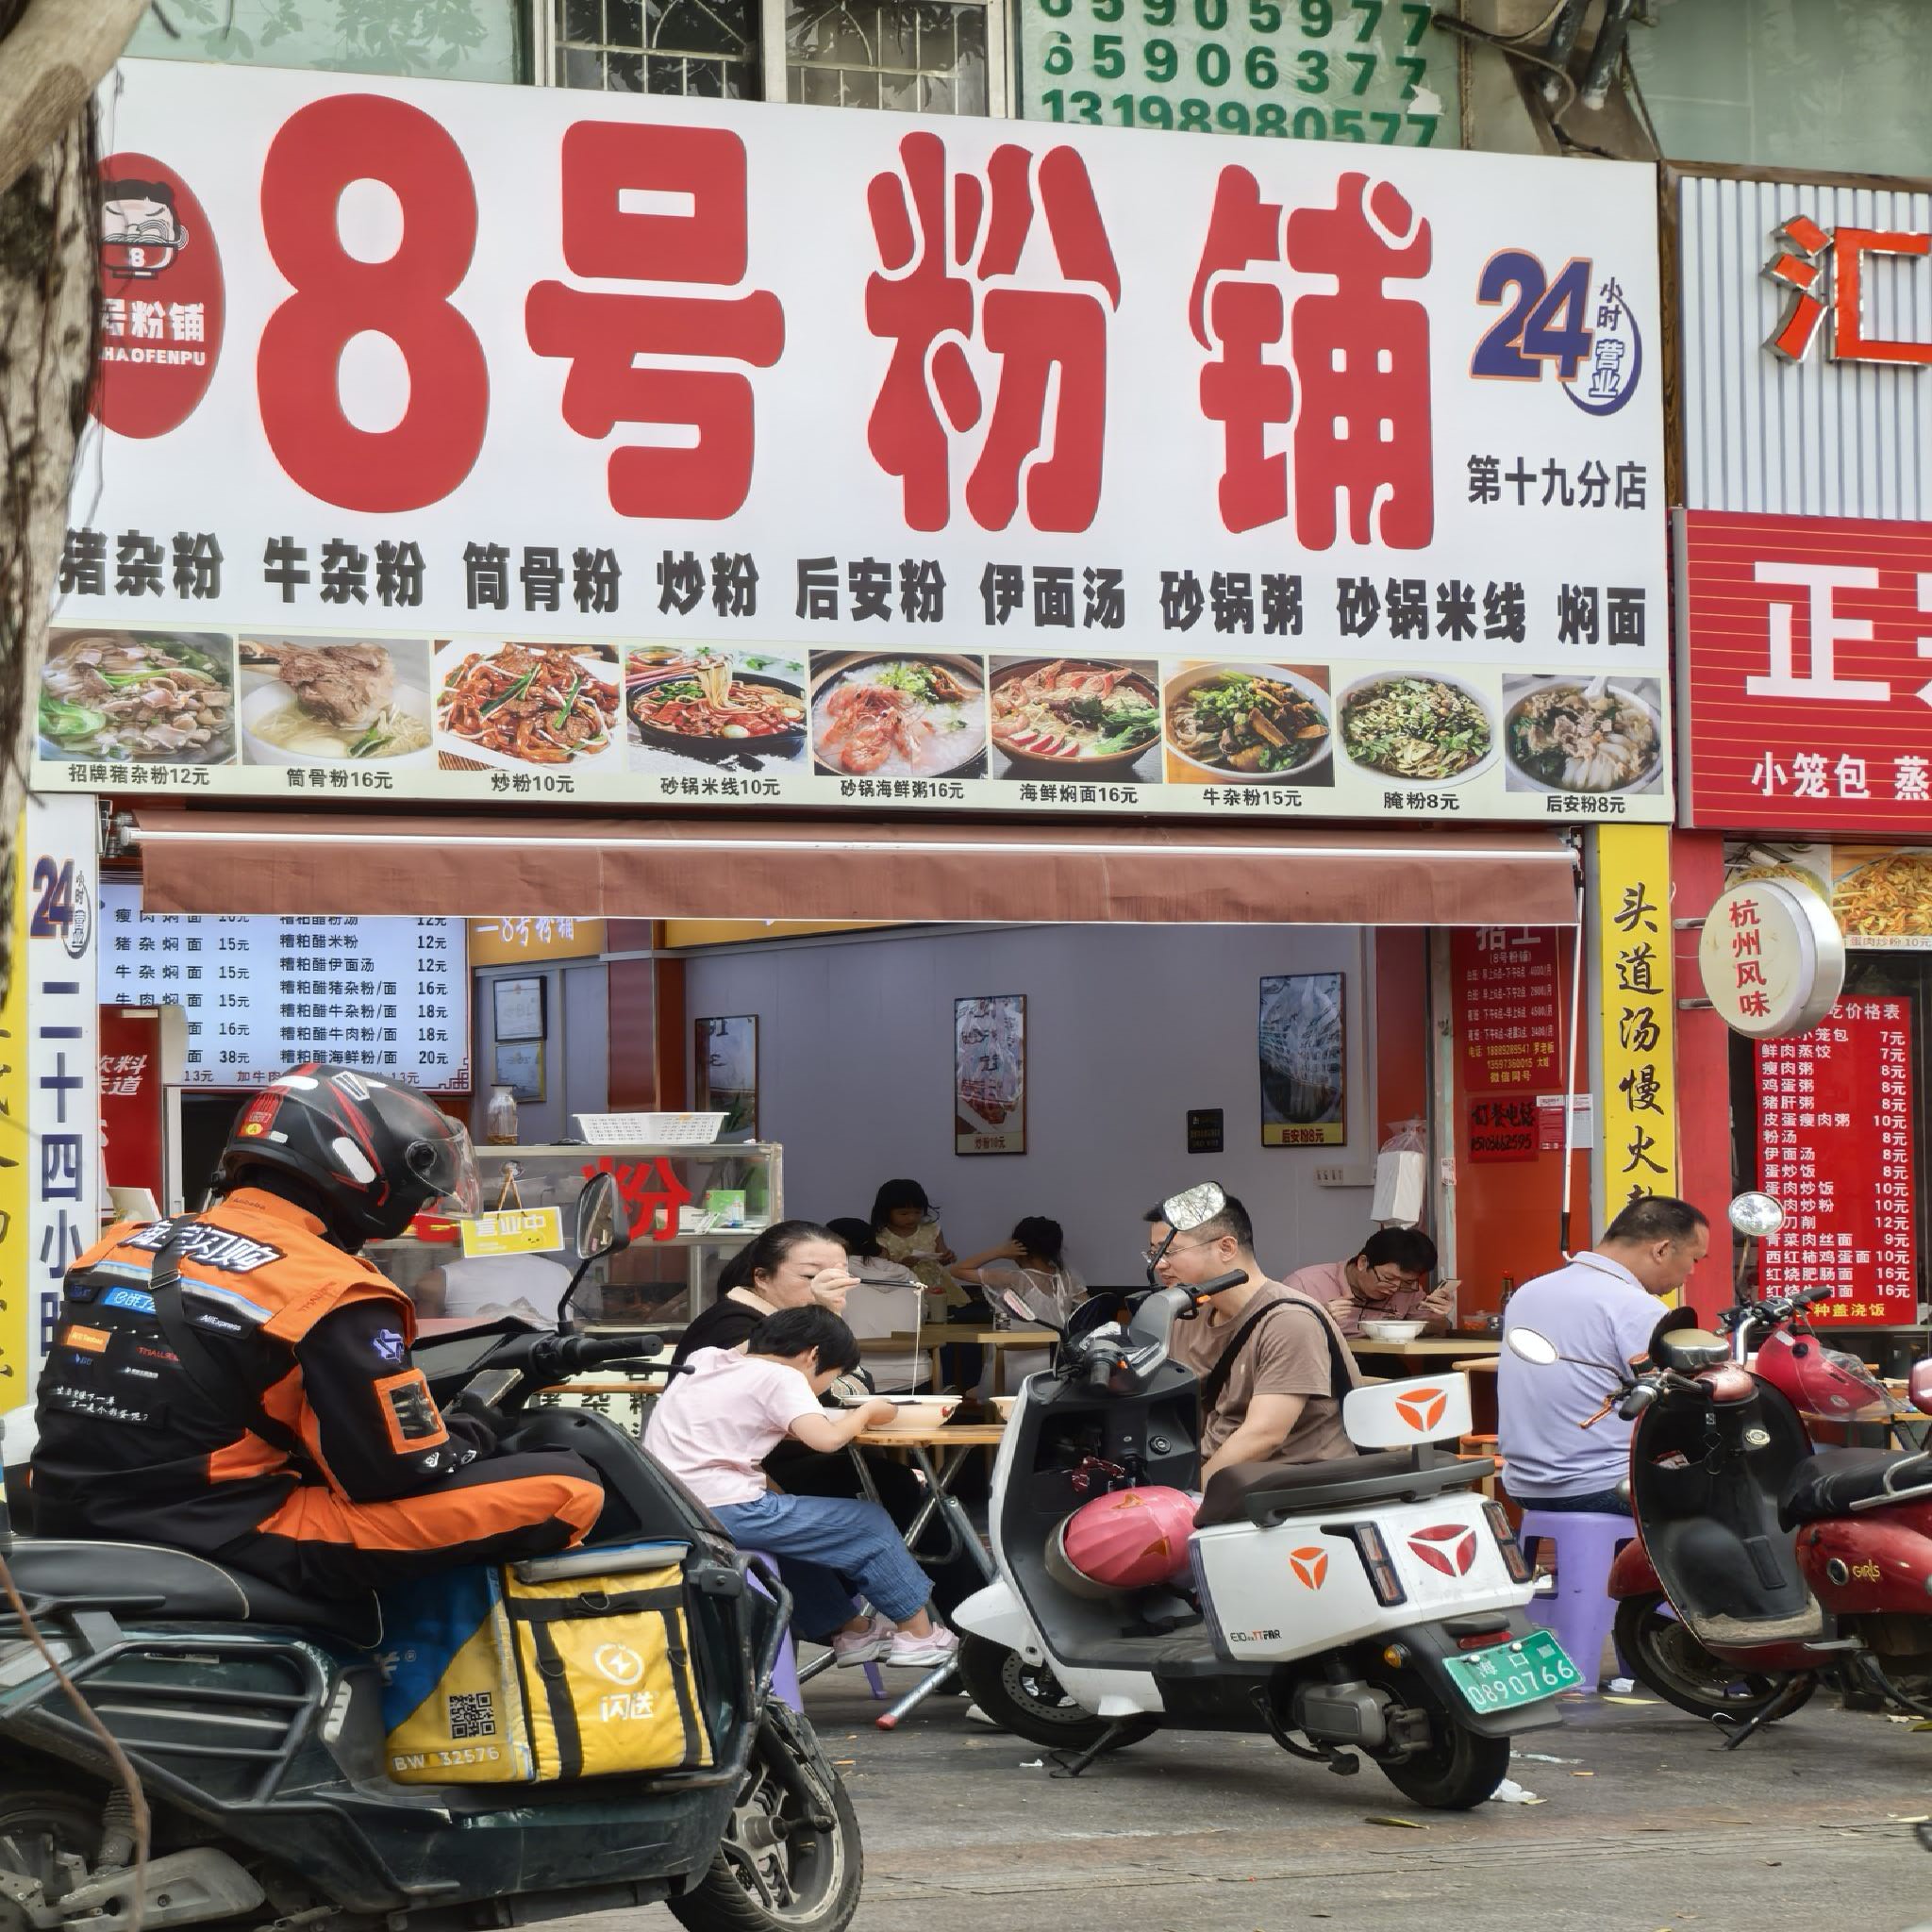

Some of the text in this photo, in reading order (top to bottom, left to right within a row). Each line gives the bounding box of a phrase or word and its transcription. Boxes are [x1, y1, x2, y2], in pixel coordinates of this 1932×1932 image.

[1044, 31, 1427, 99] 65906377
[1041, 90, 1439, 147] 13198980577
[1762, 214, 1932, 366] 汇
[258, 93, 1434, 550] 8号粉铺
[1469, 247, 1594, 383] 24
[1466, 454, 1647, 510] 第十九分店
[262, 536, 426, 607] 牛杂粉
[462, 541, 623, 614] 筒骨粉
[657, 550, 759, 618] 炒粉
[795, 556, 947, 624] 后安粉
[979, 561, 1125, 629] 伊面汤
[1159, 570, 1303, 636] 砂锅粥
[1336, 576, 1526, 643] 砂锅米线
[1557, 582, 1646, 646] 焖面
[1751, 751, 1930, 801] 小笼包 蒸
[68, 761, 1626, 815] 招牌猪杂粉12元 筒骨粉16元 炒粉10元 砂锅米线10元 砂锅海鲜粥16元 海鲜焖面16元 牛杂粉15元 腌粉8元 后安粉8元
[30, 854, 75, 939] 24
[115, 936, 250, 952] 猪杂焖面 15元
[417, 935, 449, 949] 12元
[417, 958, 449, 973] 12元
[1729, 899, 1771, 1019] 杭州风味
[115, 964, 250, 980] 牛杂焖面 15元
[417, 981, 449, 995] 16元
[115, 992, 250, 1008] 牛肉焖面 15元
[417, 1004, 449, 1019] 18元
[218, 1022, 250, 1036] 16元
[417, 1027, 449, 1041] 18元
[1880, 1031, 1906, 1046] 7元
[218, 1050, 250, 1064] 38元
[417, 1050, 449, 1065] 20元
[1761, 1044, 1906, 1063] 鲜肉蒸饺 7元
[1762, 1061, 1907, 1079] 瘦肉粥 8元
[1762, 1078, 1907, 1096] 鸡蛋粥 8元
[1762, 1095, 1907, 1113] 猪肝粥 8元
[1763, 1112, 1907, 1130] 皮蛋瘦肉粥 10元
[1763, 1129, 1907, 1146] 粉汤 8元
[1764, 1146, 1907, 1163] 伊面汤 8元
[1765, 1164, 1908, 1180] 蛋炒饭 8元
[1765, 1181, 1909, 1197] 蛋肉炒饭 10元
[1779, 1199, 1909, 1214] 肉炒粉 10元
[1874, 1217, 1909, 1231] 12元
[1766, 1233, 1910, 1248] 青菜肉丝面 9元
[1766, 1250, 1910, 1265] 西红柿鸡蛋面 10元
[1766, 1267, 1910, 1282] 红烧肥肠面 16元
[1876, 1285, 1910, 1299] 16元
[1467, 1659, 1574, 1706] 0890766
[598, 1691, 656, 1723] 闪送
[392, 1746, 500, 1772] BW 32576
